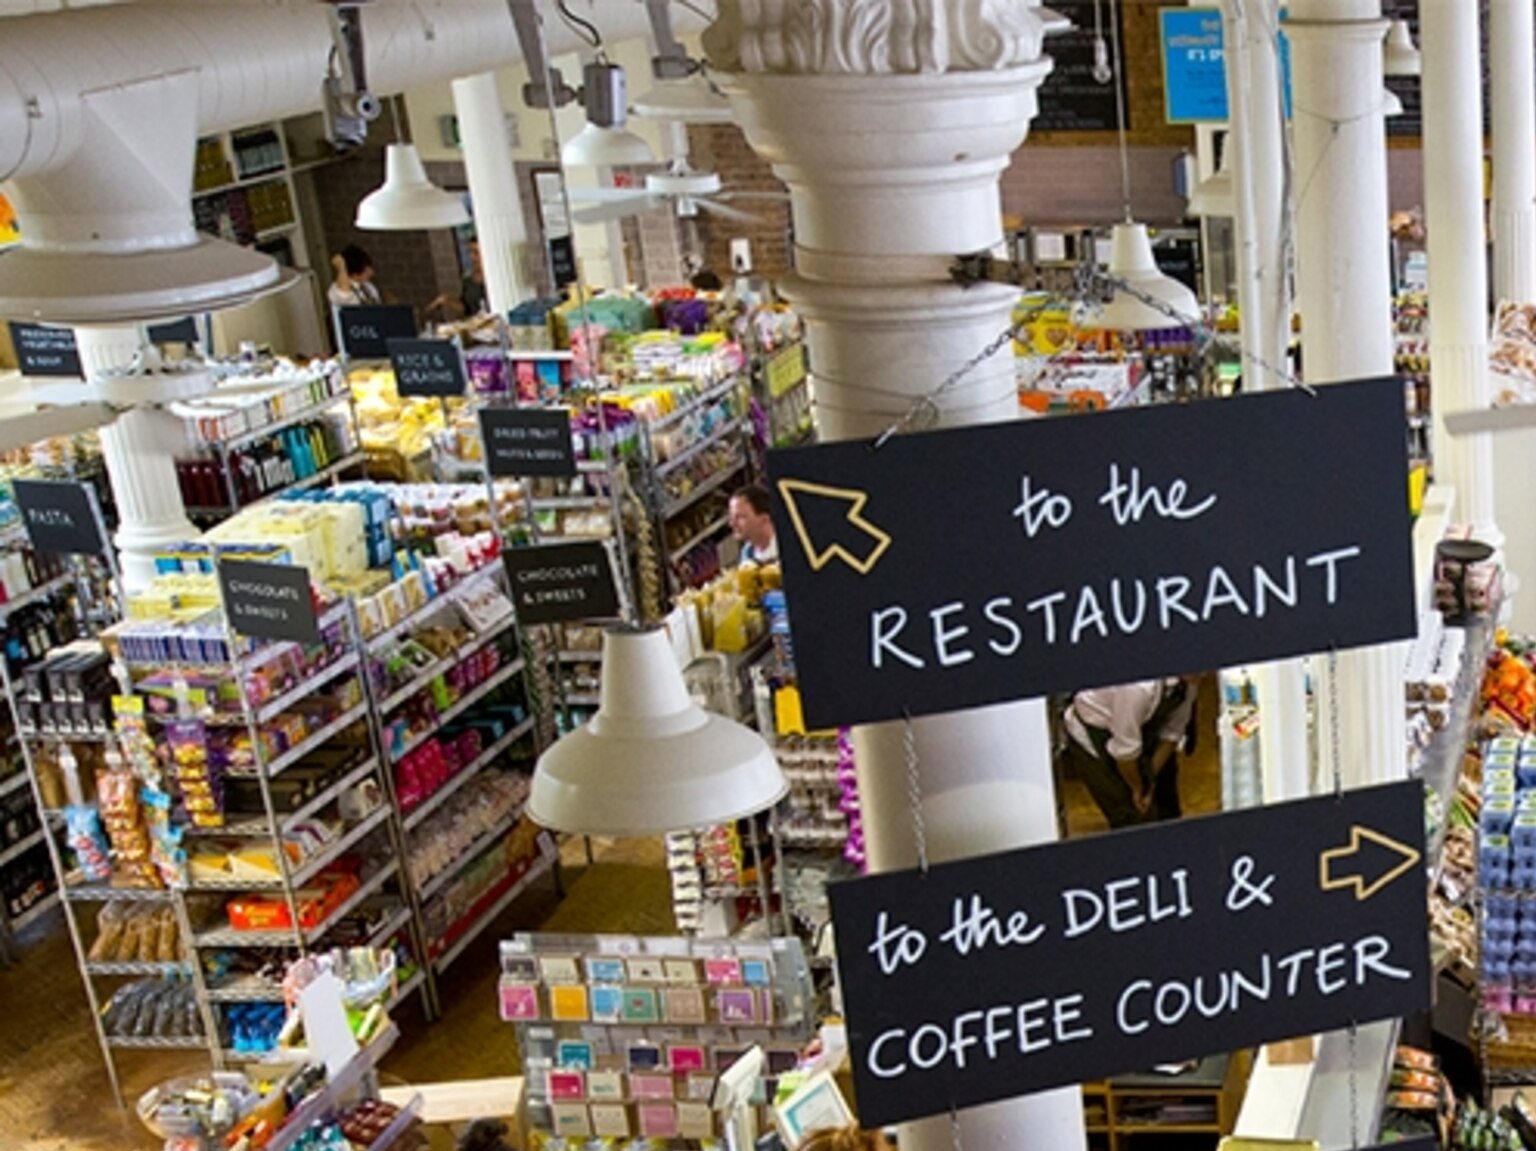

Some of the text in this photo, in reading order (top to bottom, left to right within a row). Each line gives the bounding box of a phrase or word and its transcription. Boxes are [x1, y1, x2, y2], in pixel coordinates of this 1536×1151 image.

[396, 352, 430, 367] RICE
[1013, 464, 1217, 537] to the
[28, 507, 76, 527] PASTA
[517, 563, 598, 582] CHOCOLATE
[229, 580, 299, 601] CHOCOLATE
[536, 587, 586, 603] SWEETS
[869, 545, 1361, 669] RESTAURANT
[868, 855, 1275, 974] to the DELI &
[868, 935, 1412, 1077] COFFEE COUNTER
